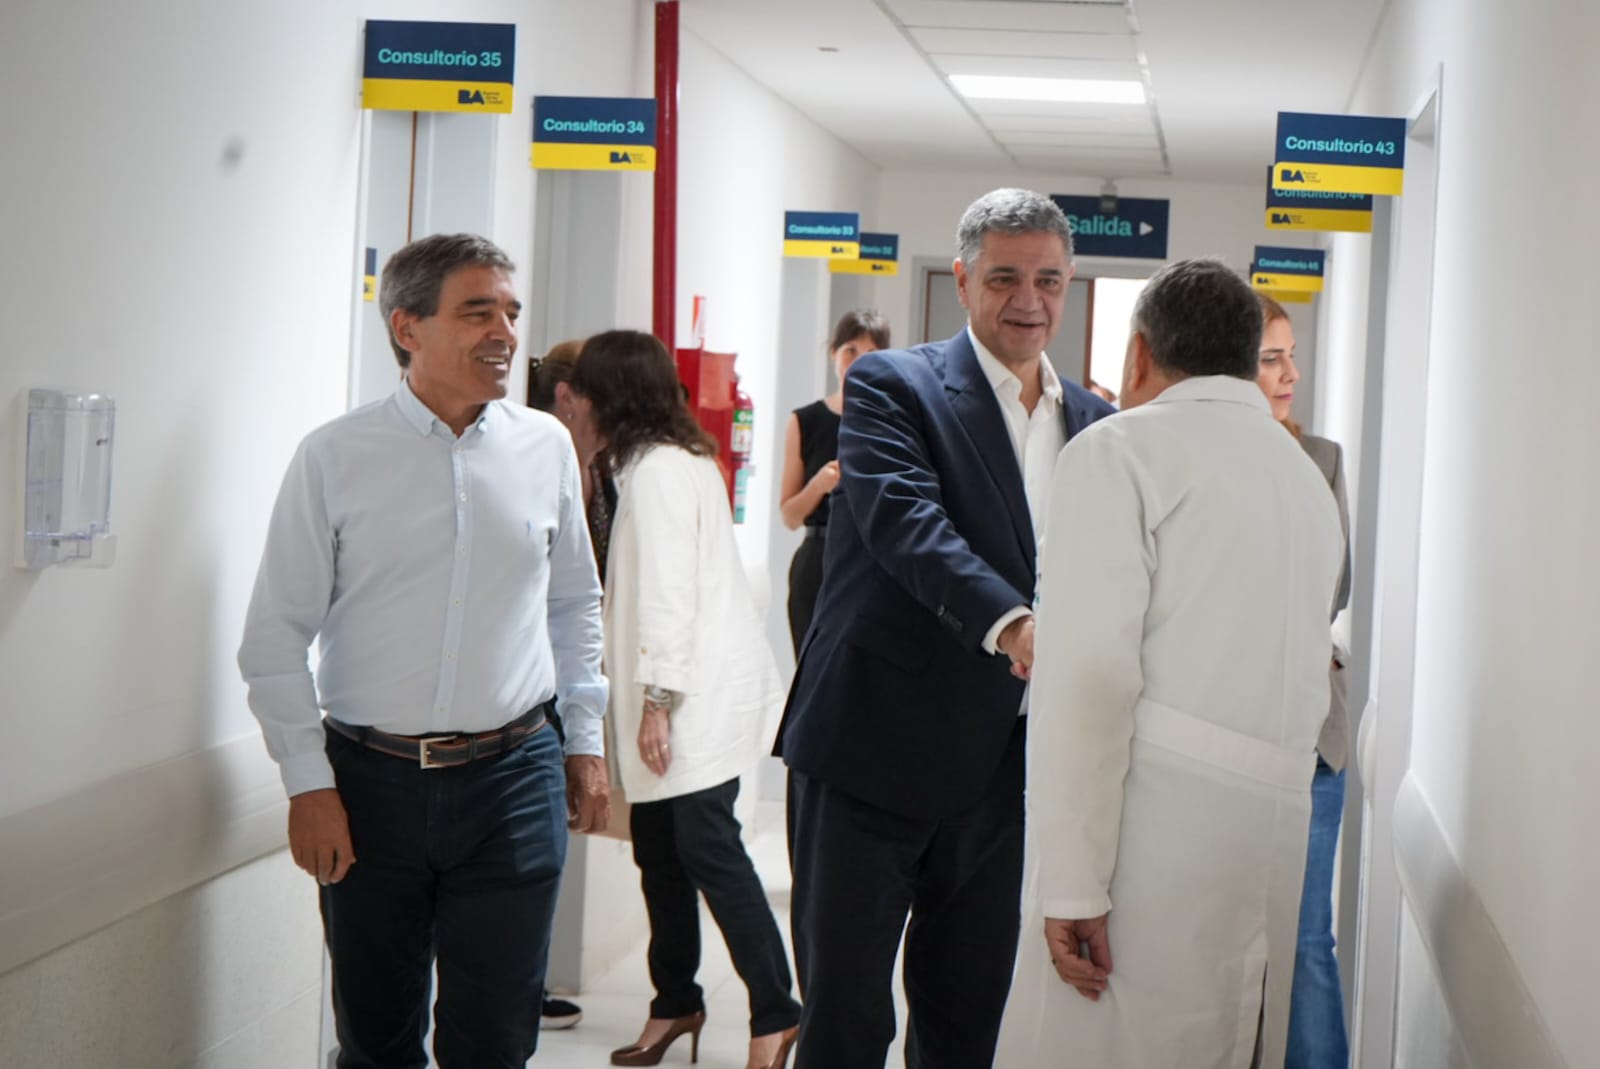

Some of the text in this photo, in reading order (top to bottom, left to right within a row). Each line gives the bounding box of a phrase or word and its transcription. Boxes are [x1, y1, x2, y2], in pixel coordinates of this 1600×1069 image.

[378, 48, 502, 67] Consultorio 35
[458, 89, 485, 105] BA
[543, 118, 645, 134] Consultorio 34
[1285, 136, 1395, 155] Consultorio 43
[610, 152, 632, 164] BA
[1281, 169, 1304, 183] BA
[1067, 213, 1133, 237] Salida
[1271, 213, 1291, 225] BA
[788, 223, 841, 235] Consultorio
